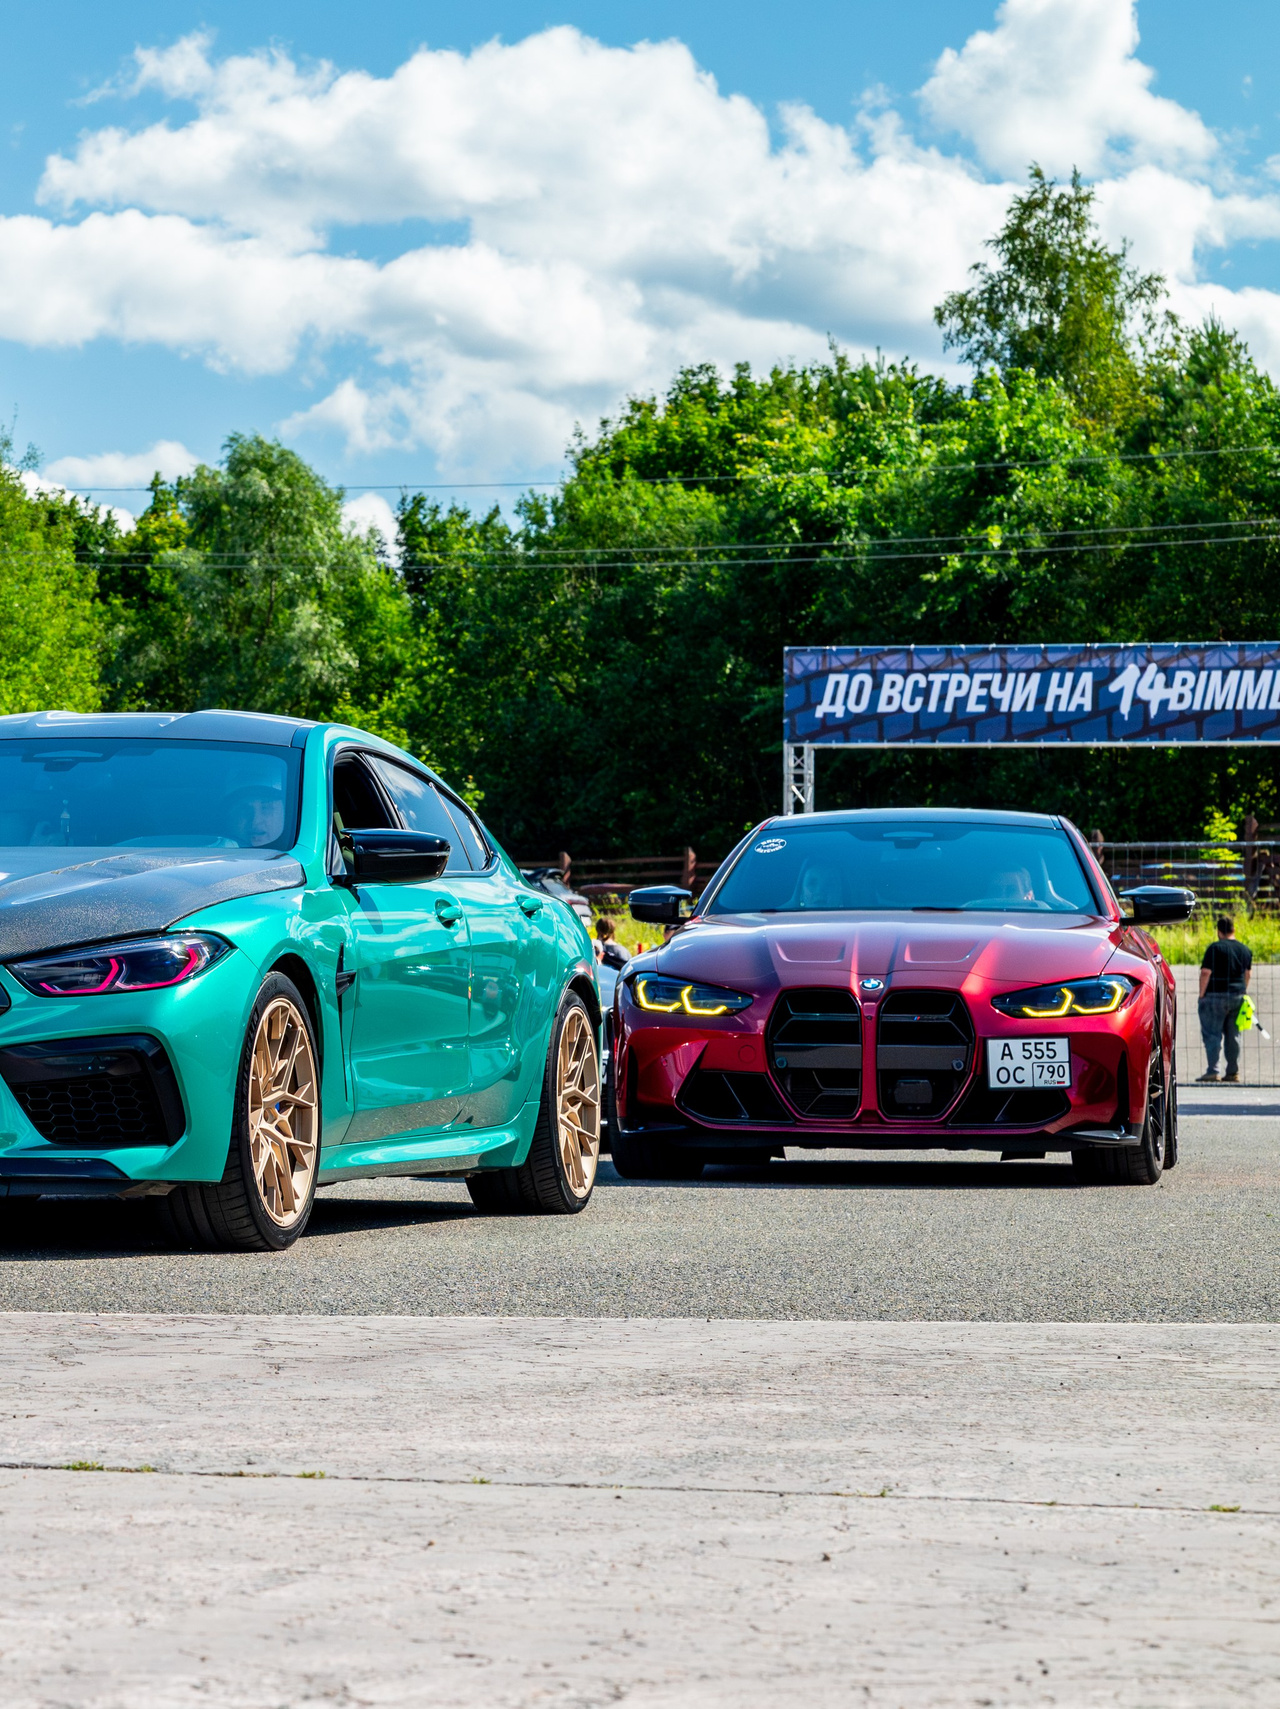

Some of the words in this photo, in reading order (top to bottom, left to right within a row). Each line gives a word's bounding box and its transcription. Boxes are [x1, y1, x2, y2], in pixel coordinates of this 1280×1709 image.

[814, 673, 873, 719] ДО
[876, 672, 1042, 713] ВСТРЕЧИ
[1044, 671, 1094, 712] НА
[1000, 1042, 1014, 1061] А
[1021, 1041, 1057, 1060] 555
[996, 1066, 1026, 1085] ОС
[1036, 1064, 1066, 1079] 790
